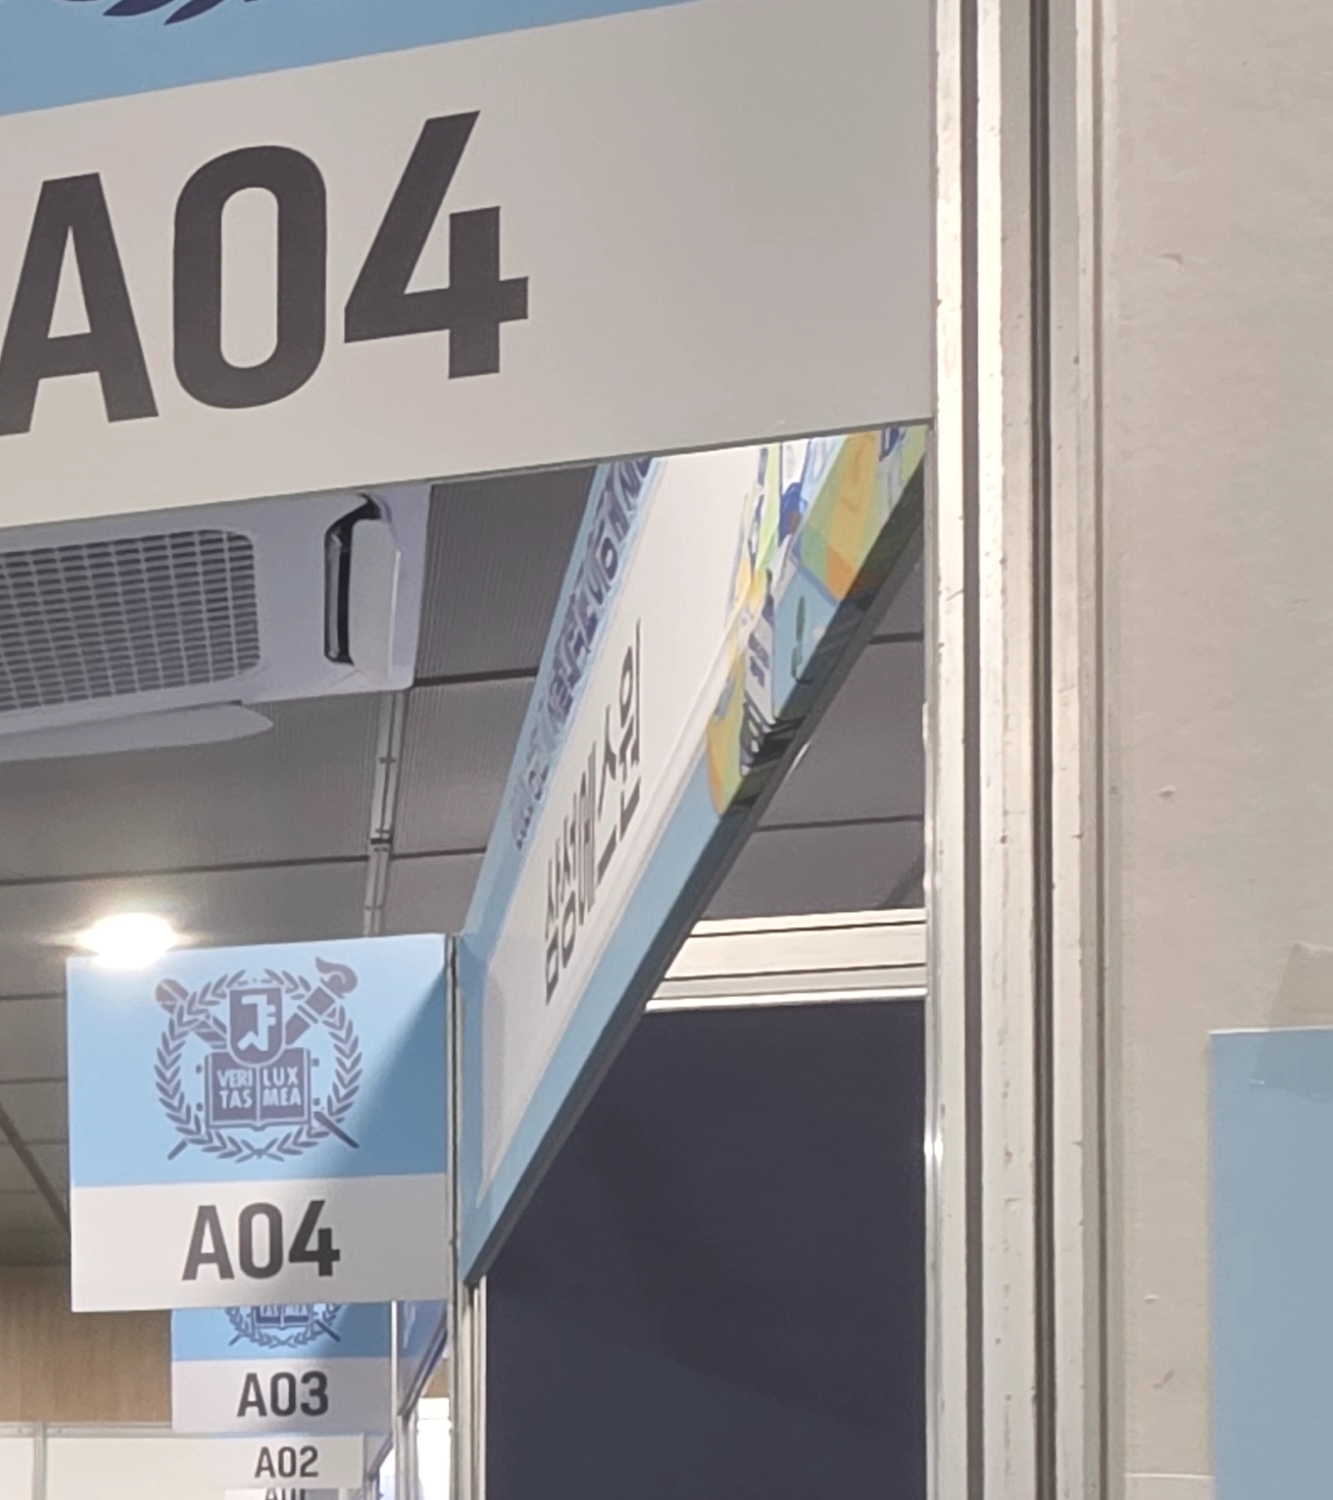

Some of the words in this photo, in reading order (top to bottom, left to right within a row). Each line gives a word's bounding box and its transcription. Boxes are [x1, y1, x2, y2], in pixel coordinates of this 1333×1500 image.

[545, 619, 640, 1006] 삼성에스원
[216, 1069, 253, 1088] VERI
[263, 1067, 298, 1086] LUX
[219, 1089, 253, 1109] TAS
[263, 1087, 301, 1106] MEA
[182, 1200, 340, 1281] A04
[236, 1371, 329, 1417] A03
[254, 1446, 319, 1478] A02
